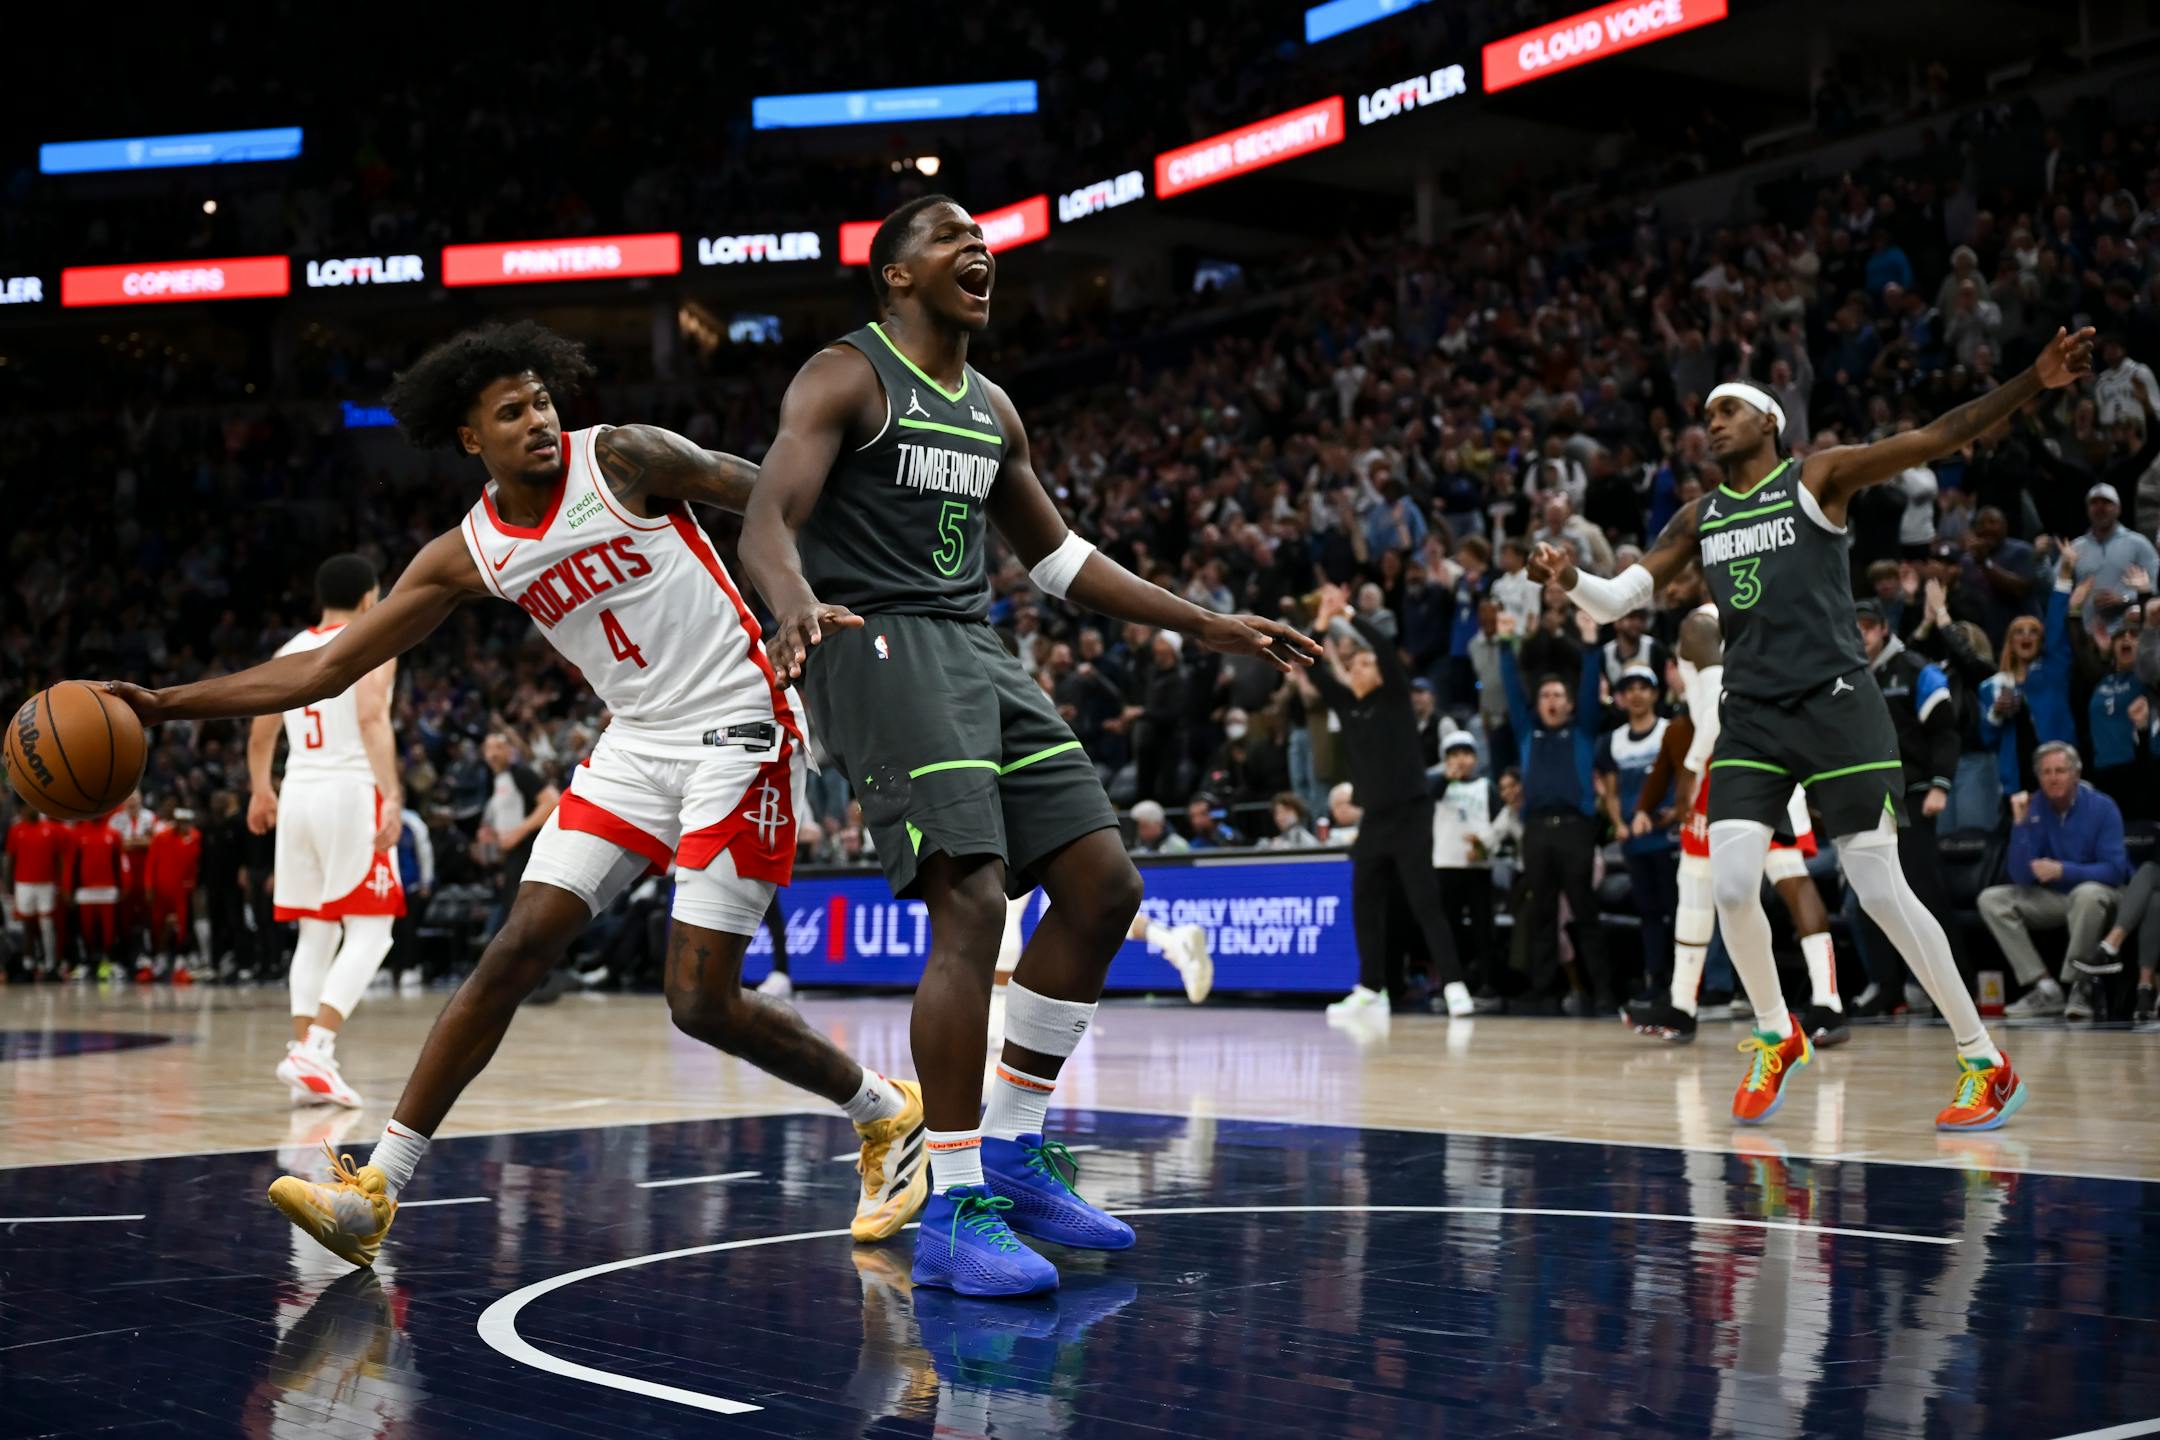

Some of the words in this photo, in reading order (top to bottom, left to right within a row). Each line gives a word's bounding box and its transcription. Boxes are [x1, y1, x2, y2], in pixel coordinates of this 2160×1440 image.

[1518, 21, 1602, 70] CLOUD
[1605, 0, 1683, 42] VOICE
[1358, 64, 1466, 125] LOFFLER
[1167, 143, 1233, 185] CYBER
[1233, 110, 1330, 164] SECURITY
[1059, 170, 1145, 223] LOFFLER
[306, 255, 424, 287] LOFFLER
[502, 245, 622, 275] PRINTERS
[699, 232, 821, 265] LOFFLER
[0, 276, 43, 303] LER
[122, 268, 225, 296] COPIERS
[566, 491, 599, 518] credit
[569, 501, 604, 529] karma
[932, 500, 968, 576] 5
[1700, 516, 1796, 568] TIMBERWOLVES
[517, 535, 652, 630] ROCKETS
[1729, 556, 1762, 610] 3
[599, 608, 648, 669] 4
[854, 902, 929, 957] ULT
[1171, 899, 1228, 927] ONLY
[1228, 897, 1313, 927] WORTH
[1316, 896, 1340, 926] IT
[1219, 926, 1294, 954] ENJOY
[1297, 925, 1322, 954] IT
